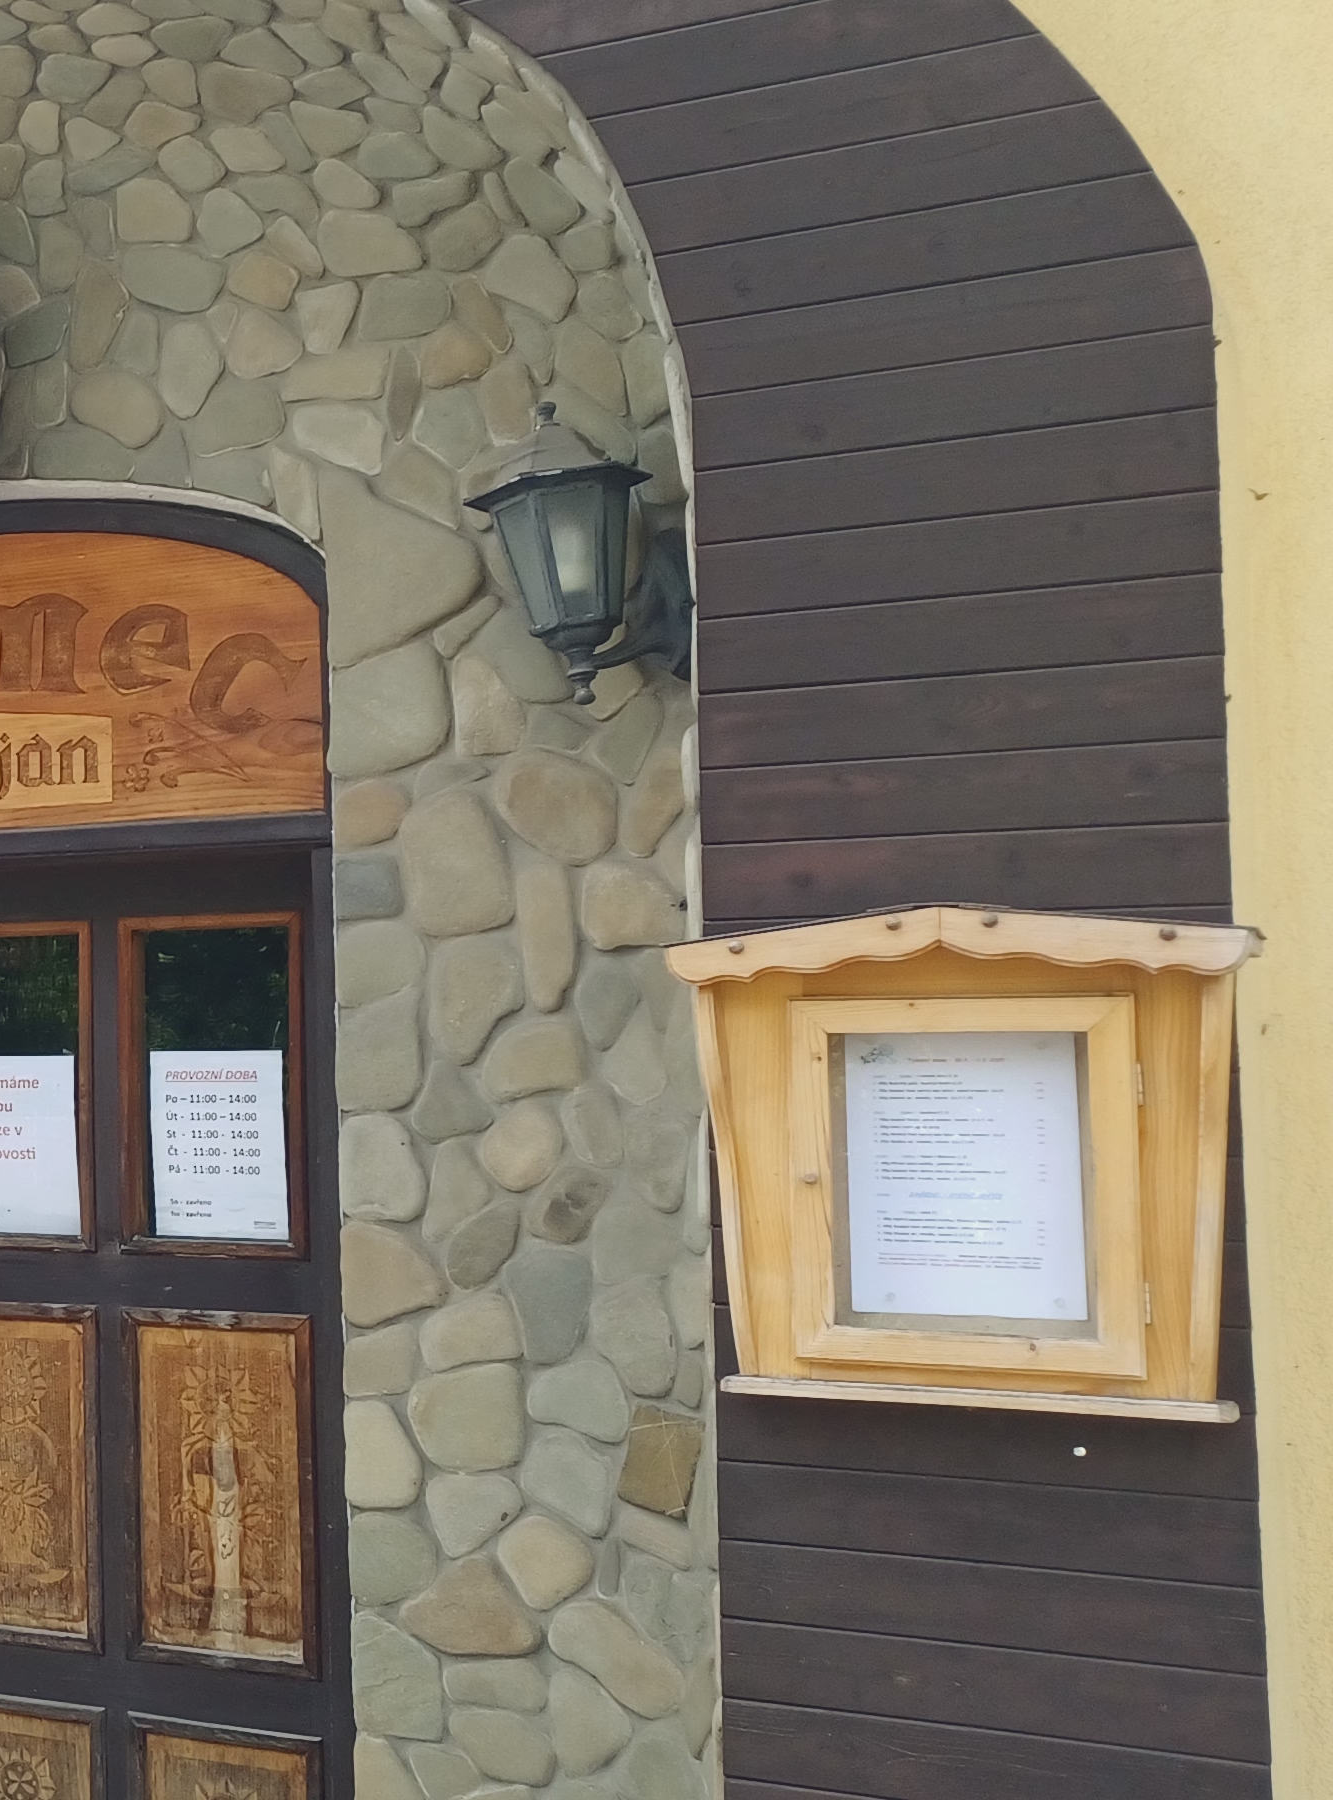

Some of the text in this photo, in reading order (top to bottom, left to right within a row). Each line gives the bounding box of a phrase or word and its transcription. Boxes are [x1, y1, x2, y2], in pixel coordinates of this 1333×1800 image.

[165, 1068, 258, 1081] PROVOZNÍ DOBA
[165, 1094, 178, 1103] Po
[190, 1094, 217, 1103] 11:00
[229, 1094, 257, 1103] 14:00
[166, 1109, 178, 1121] Út
[190, 1112, 217, 1121] 11:00
[229, 1112, 257, 1121] 14:00
[14, 1126, 23, 1136] v
[167, 1129, 177, 1139] St
[191, 1130, 219, 1139] 11:00
[231, 1130, 259, 1139] 14:00
[167, 1144, 179, 1156] Čt
[193, 1147, 220, 1157] 11:00
[233, 1148, 260, 1157] 14:00
[168, 1164, 181, 1174] Pá
[193, 1165, 220, 1174] 11:00
[233, 1166, 260, 1175] 14:00
